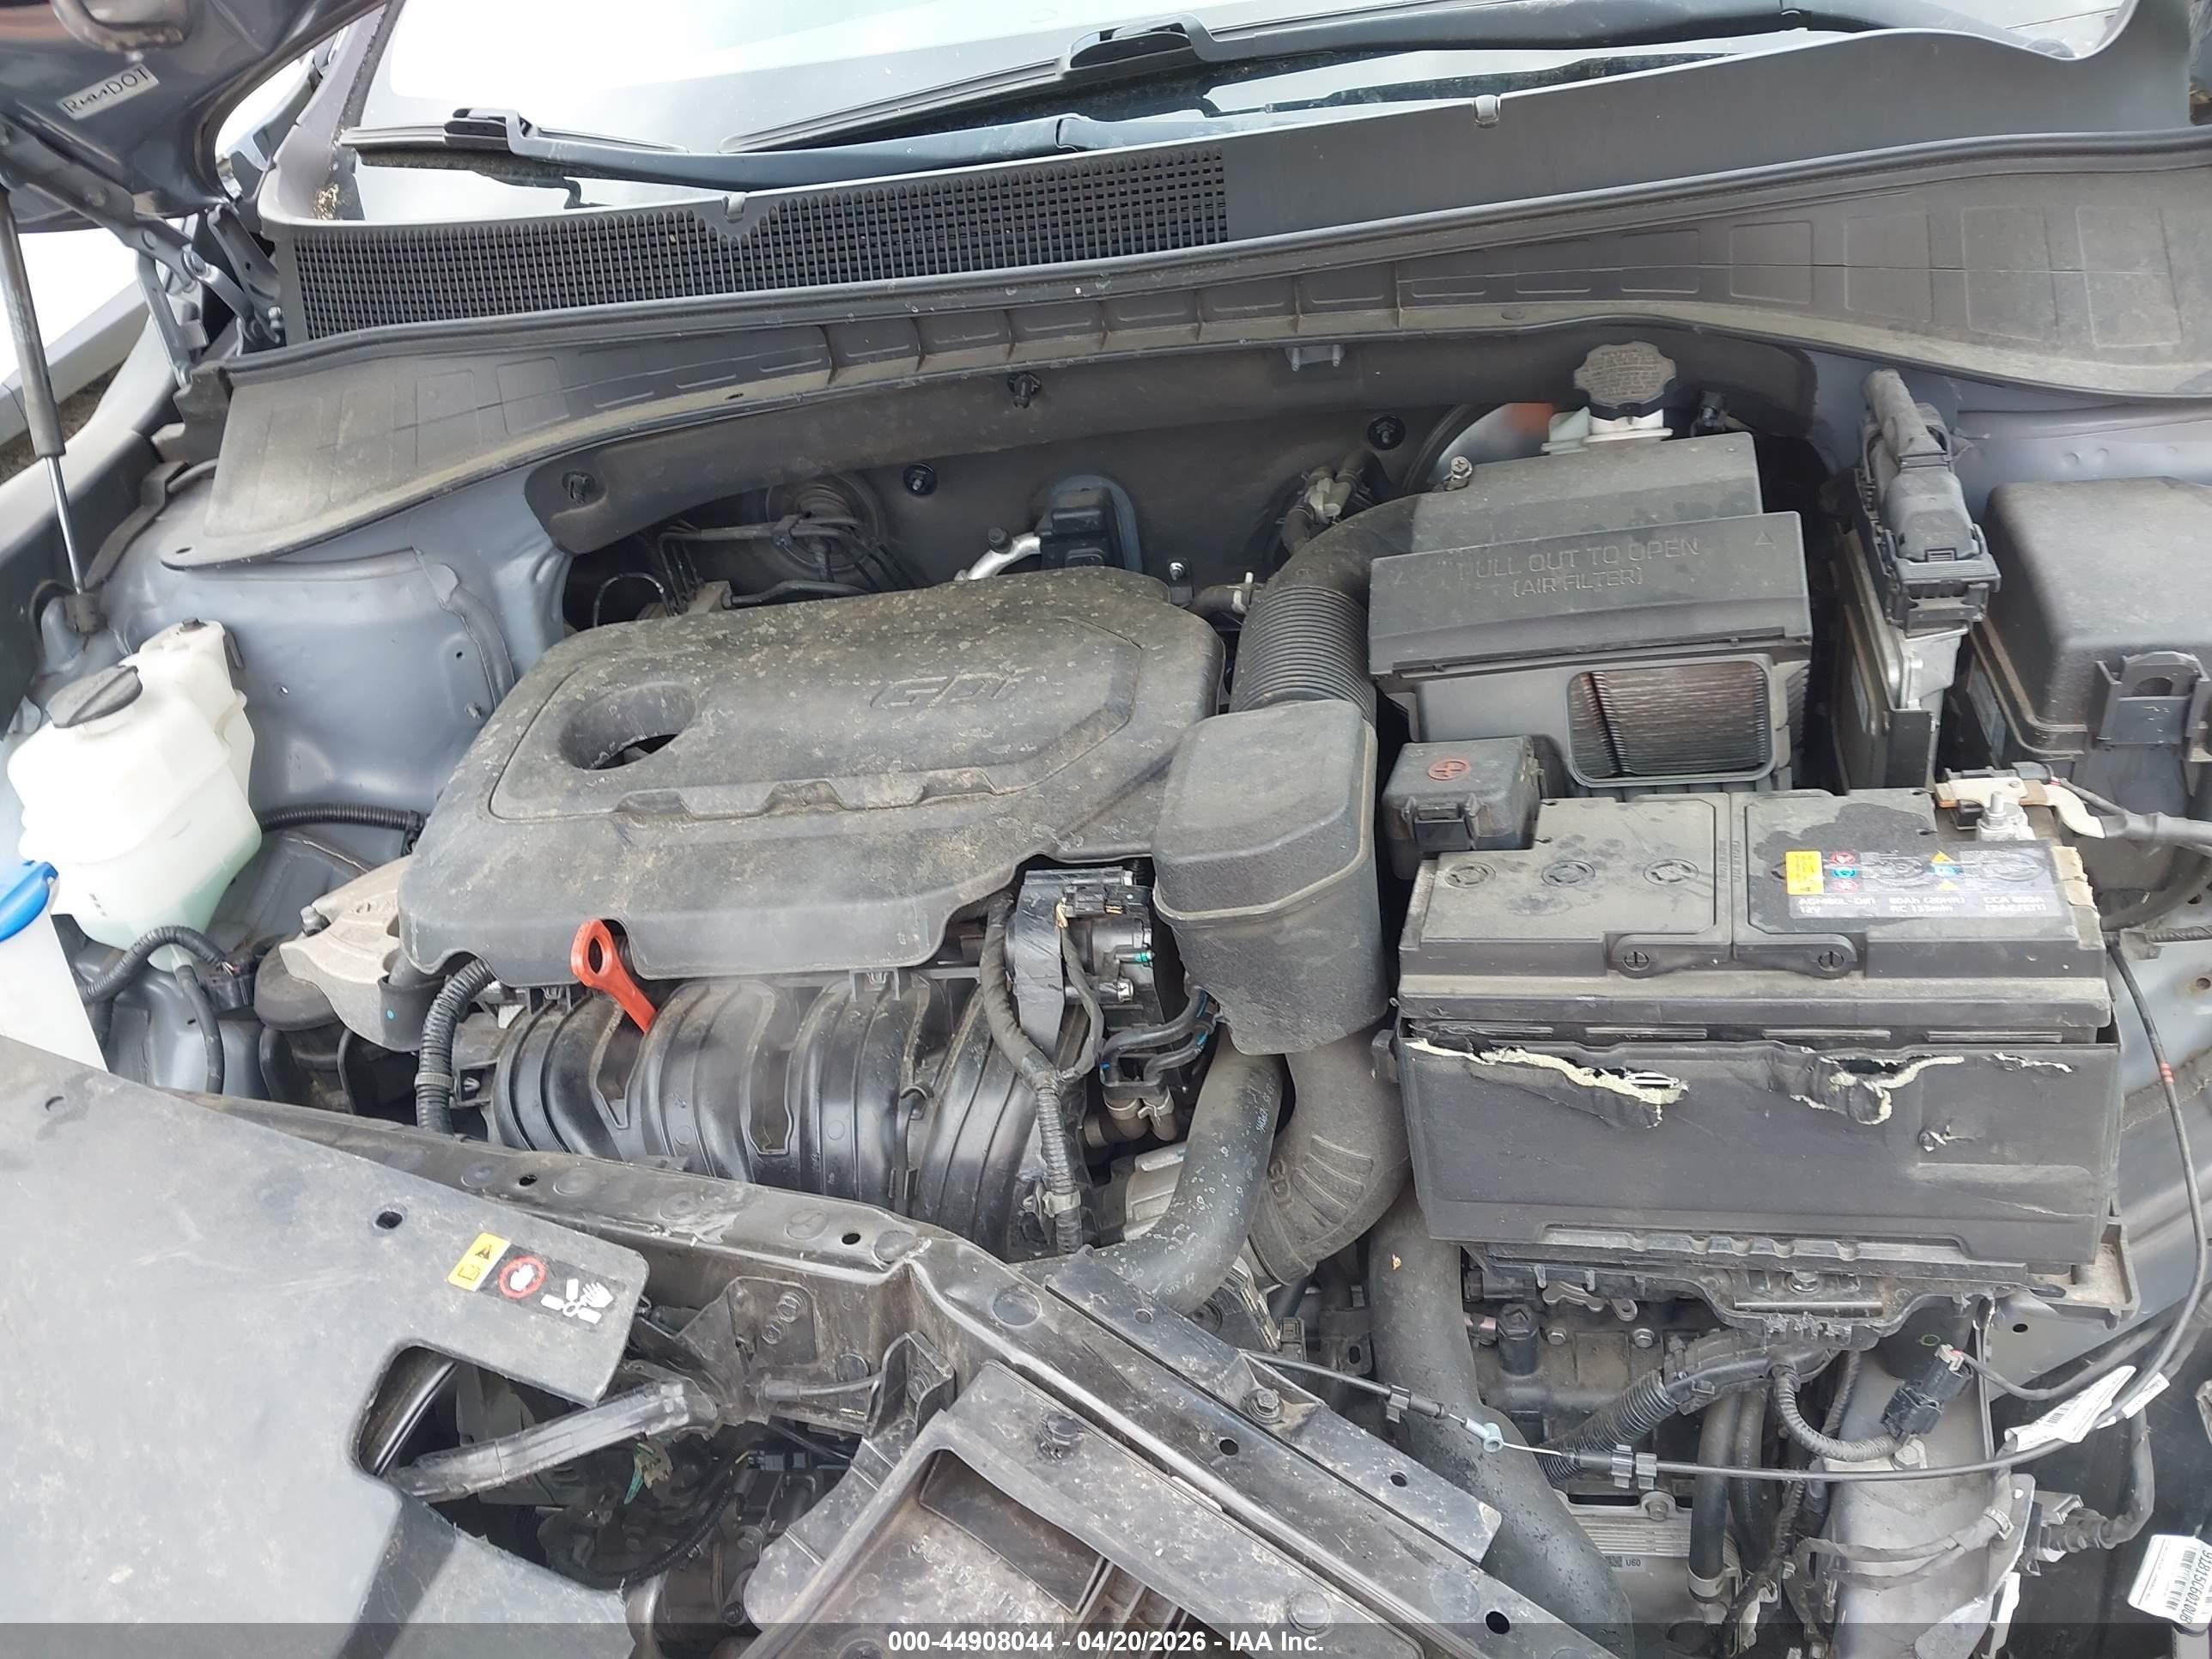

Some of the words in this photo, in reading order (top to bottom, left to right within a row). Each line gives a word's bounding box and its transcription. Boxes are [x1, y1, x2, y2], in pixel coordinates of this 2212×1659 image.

[1528, 549, 1580, 573] OUT
[1587, 545, 1621, 565] TO
[1628, 538, 1700, 562] OPEN
